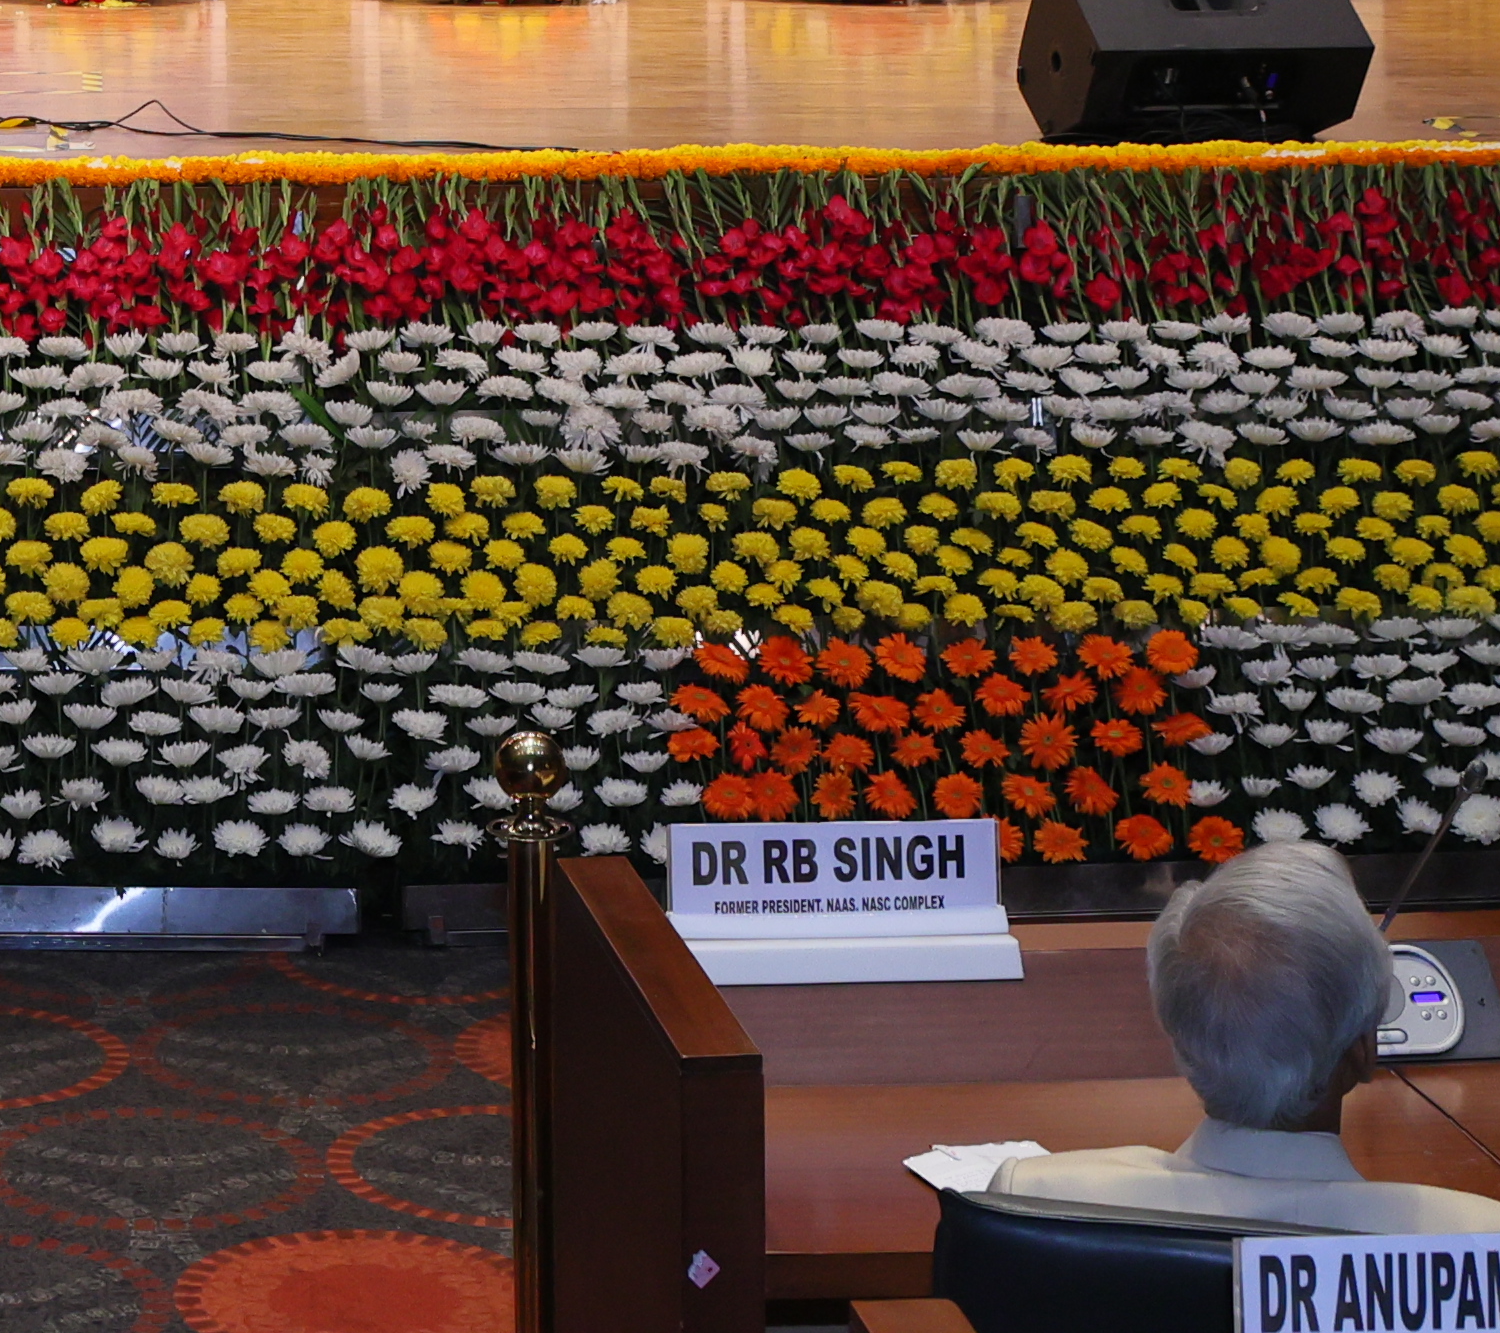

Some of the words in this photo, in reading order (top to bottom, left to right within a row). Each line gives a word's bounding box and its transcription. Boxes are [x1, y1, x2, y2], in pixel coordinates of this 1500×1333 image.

[692, 841, 748, 885] DR
[763, 839, 818, 883] RB
[834, 835, 965, 882] SINGH
[715, 901, 759, 914] FORMER
[862, 897, 891, 911] NASC
[894, 896, 945, 910] COMPLEX
[1259, 1254, 1320, 1333] DR
